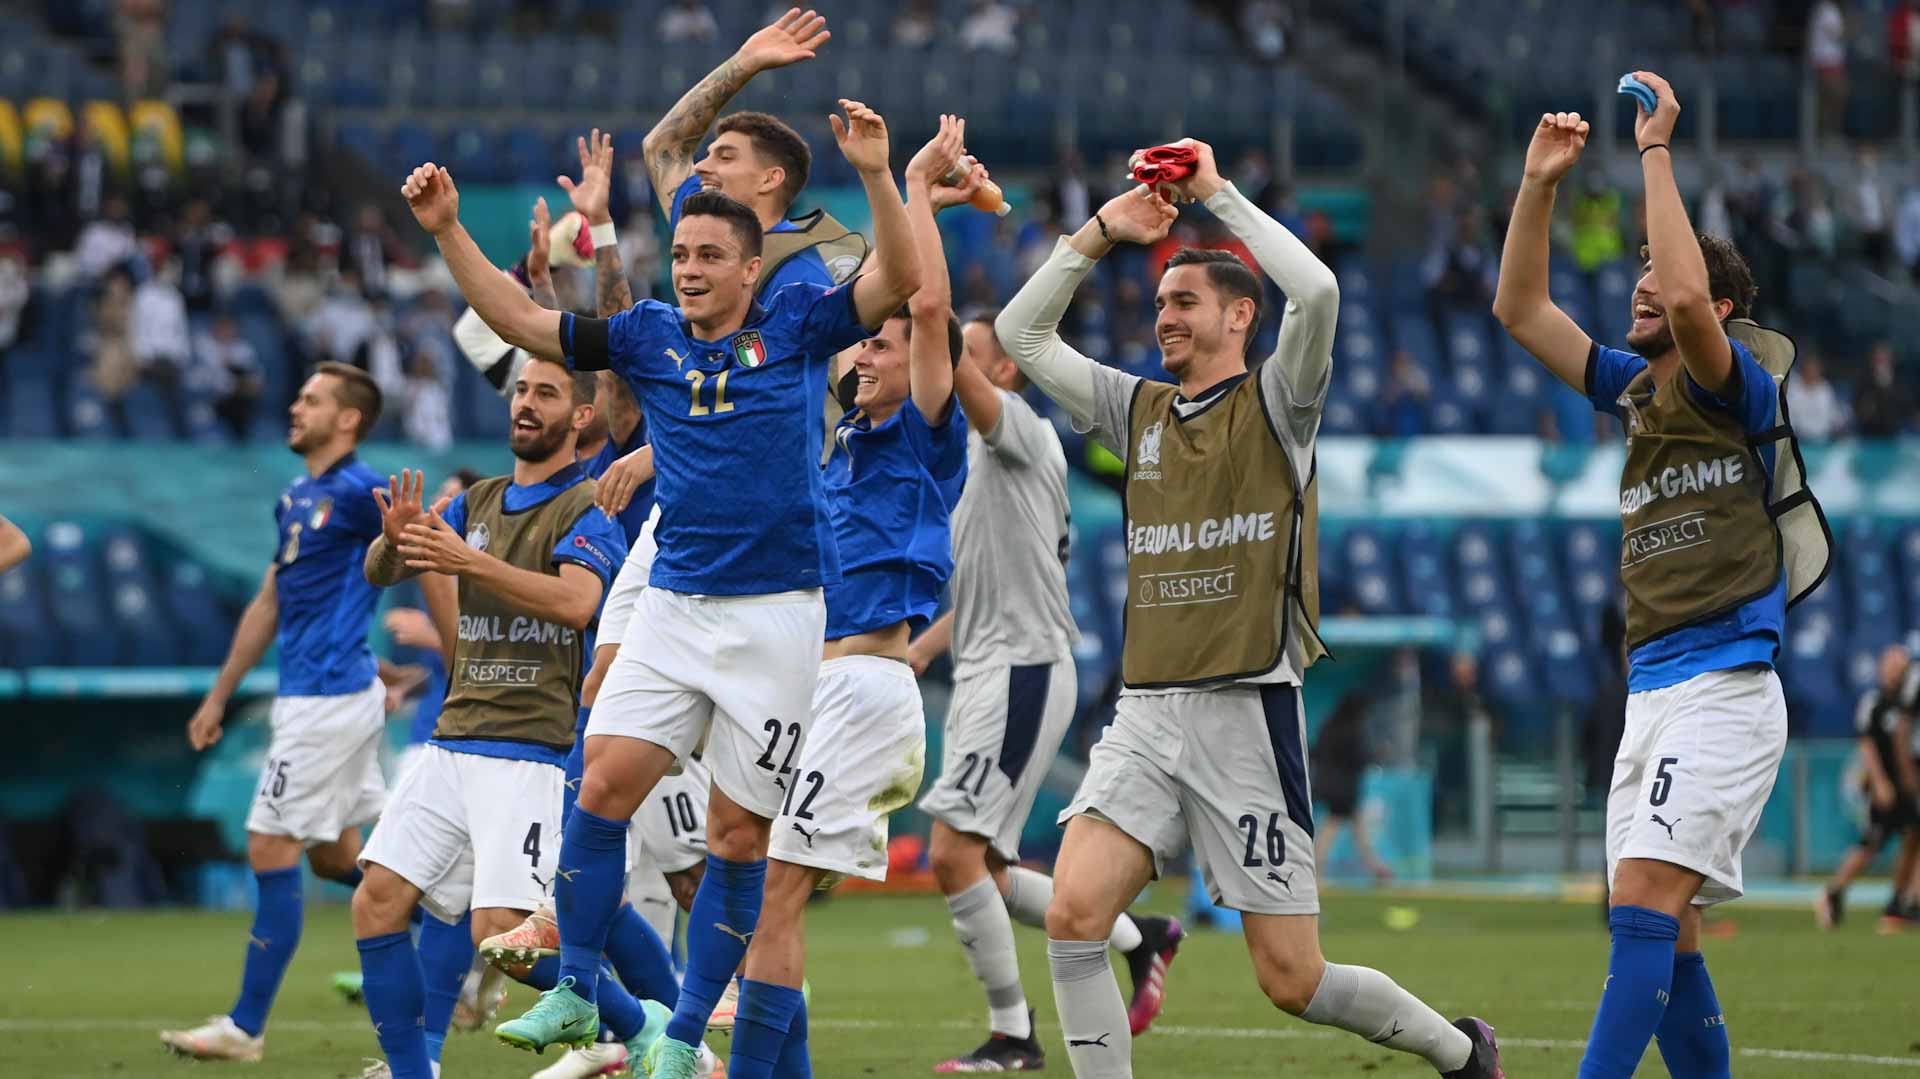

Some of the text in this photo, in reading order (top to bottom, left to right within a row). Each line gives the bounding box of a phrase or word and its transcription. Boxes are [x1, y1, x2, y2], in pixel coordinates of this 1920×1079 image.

[1660, 455, 1744, 498] GAME
[1198, 511, 1275, 550] GAME
[1629, 518, 1706, 557] RESPECT
[585, 542, 611, 567] RESPECT
[1159, 572, 1235, 599] RESPECT
[459, 615, 576, 646] QUAL GAME
[469, 664, 541, 683] RESPECT
[756, 718, 801, 775] 22
[782, 768, 825, 821] 12
[955, 751, 993, 797] 21
[1649, 757, 1679, 807] 5
[662, 792, 698, 837] 10
[523, 822, 542, 868] 4
[1238, 812, 1286, 867] 26
